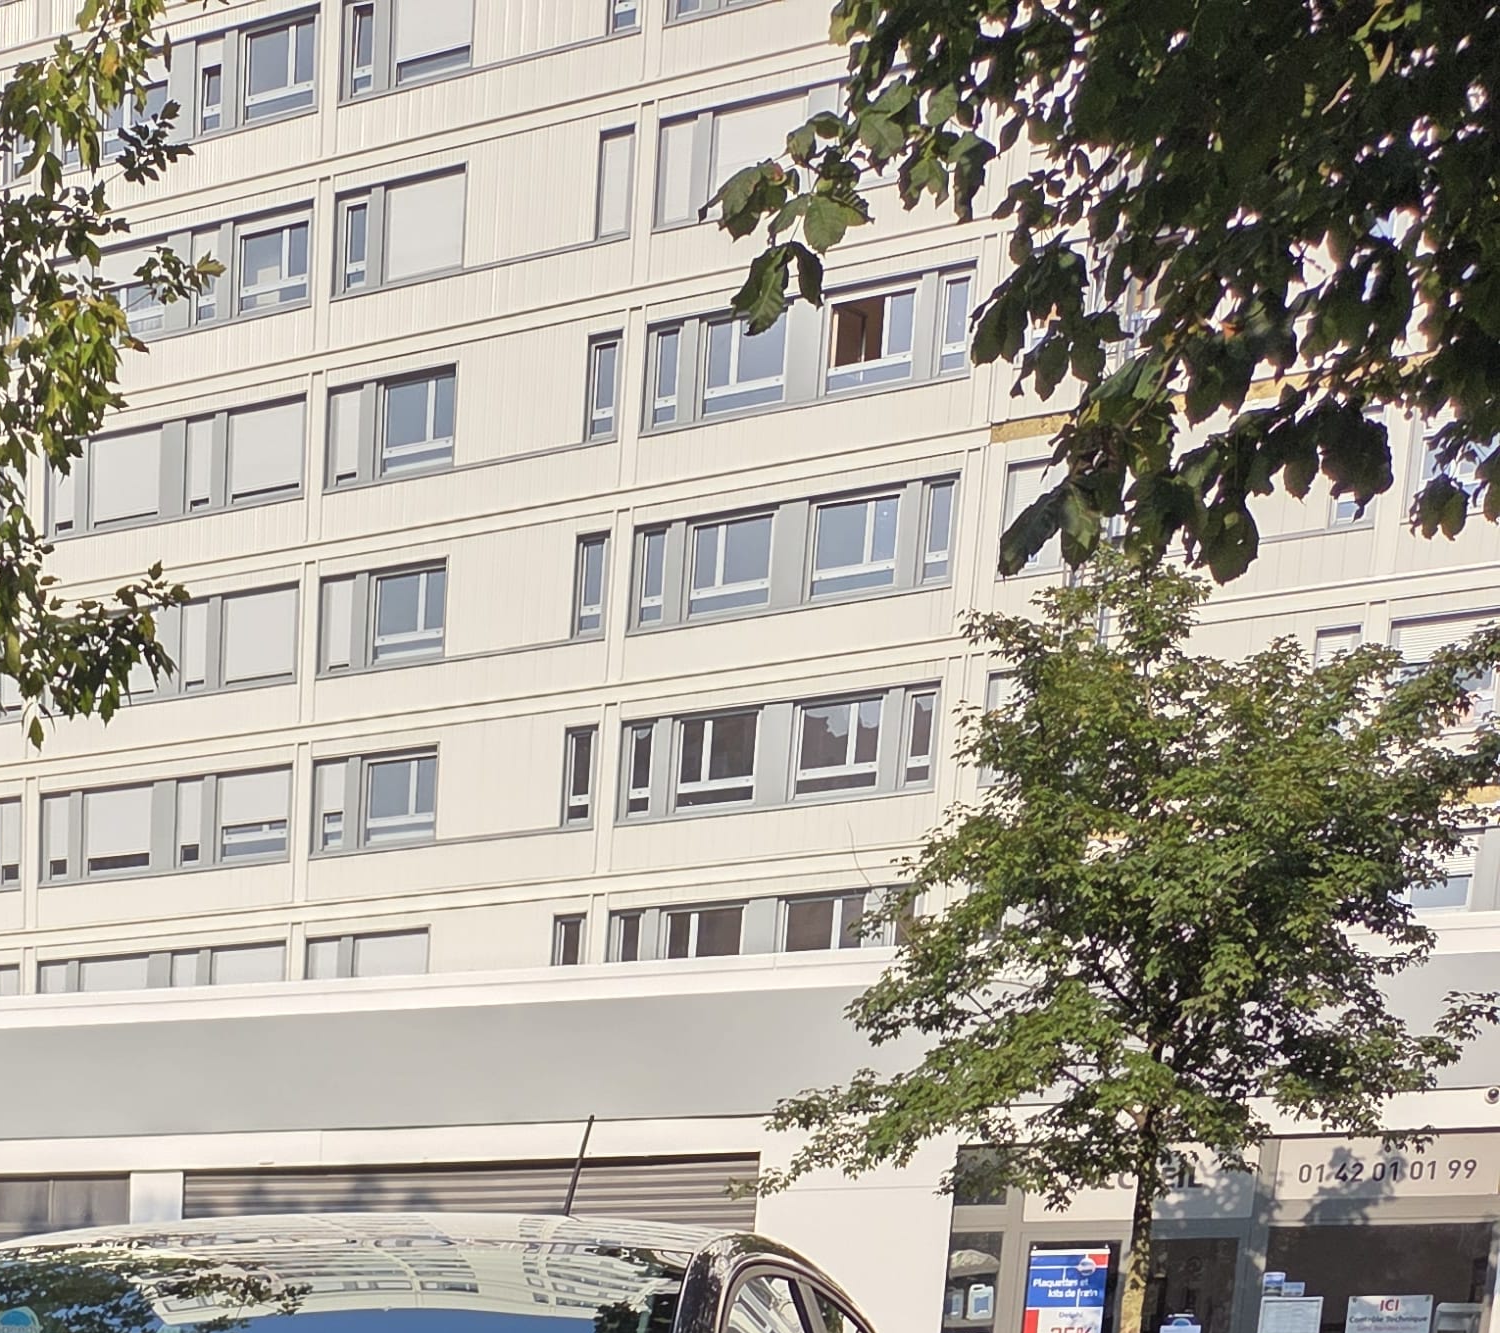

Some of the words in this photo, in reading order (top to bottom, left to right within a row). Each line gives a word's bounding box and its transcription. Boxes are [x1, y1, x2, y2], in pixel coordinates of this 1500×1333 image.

[1298, 1163, 1325, 1183] 01
[1334, 1162, 1365, 1182] 42
[1372, 1161, 1399, 1181] 01
[1409, 1160, 1437, 1180] 01
[1448, 1159, 1477, 1179] 99
[1380, 1299, 1399, 1311] ICI
